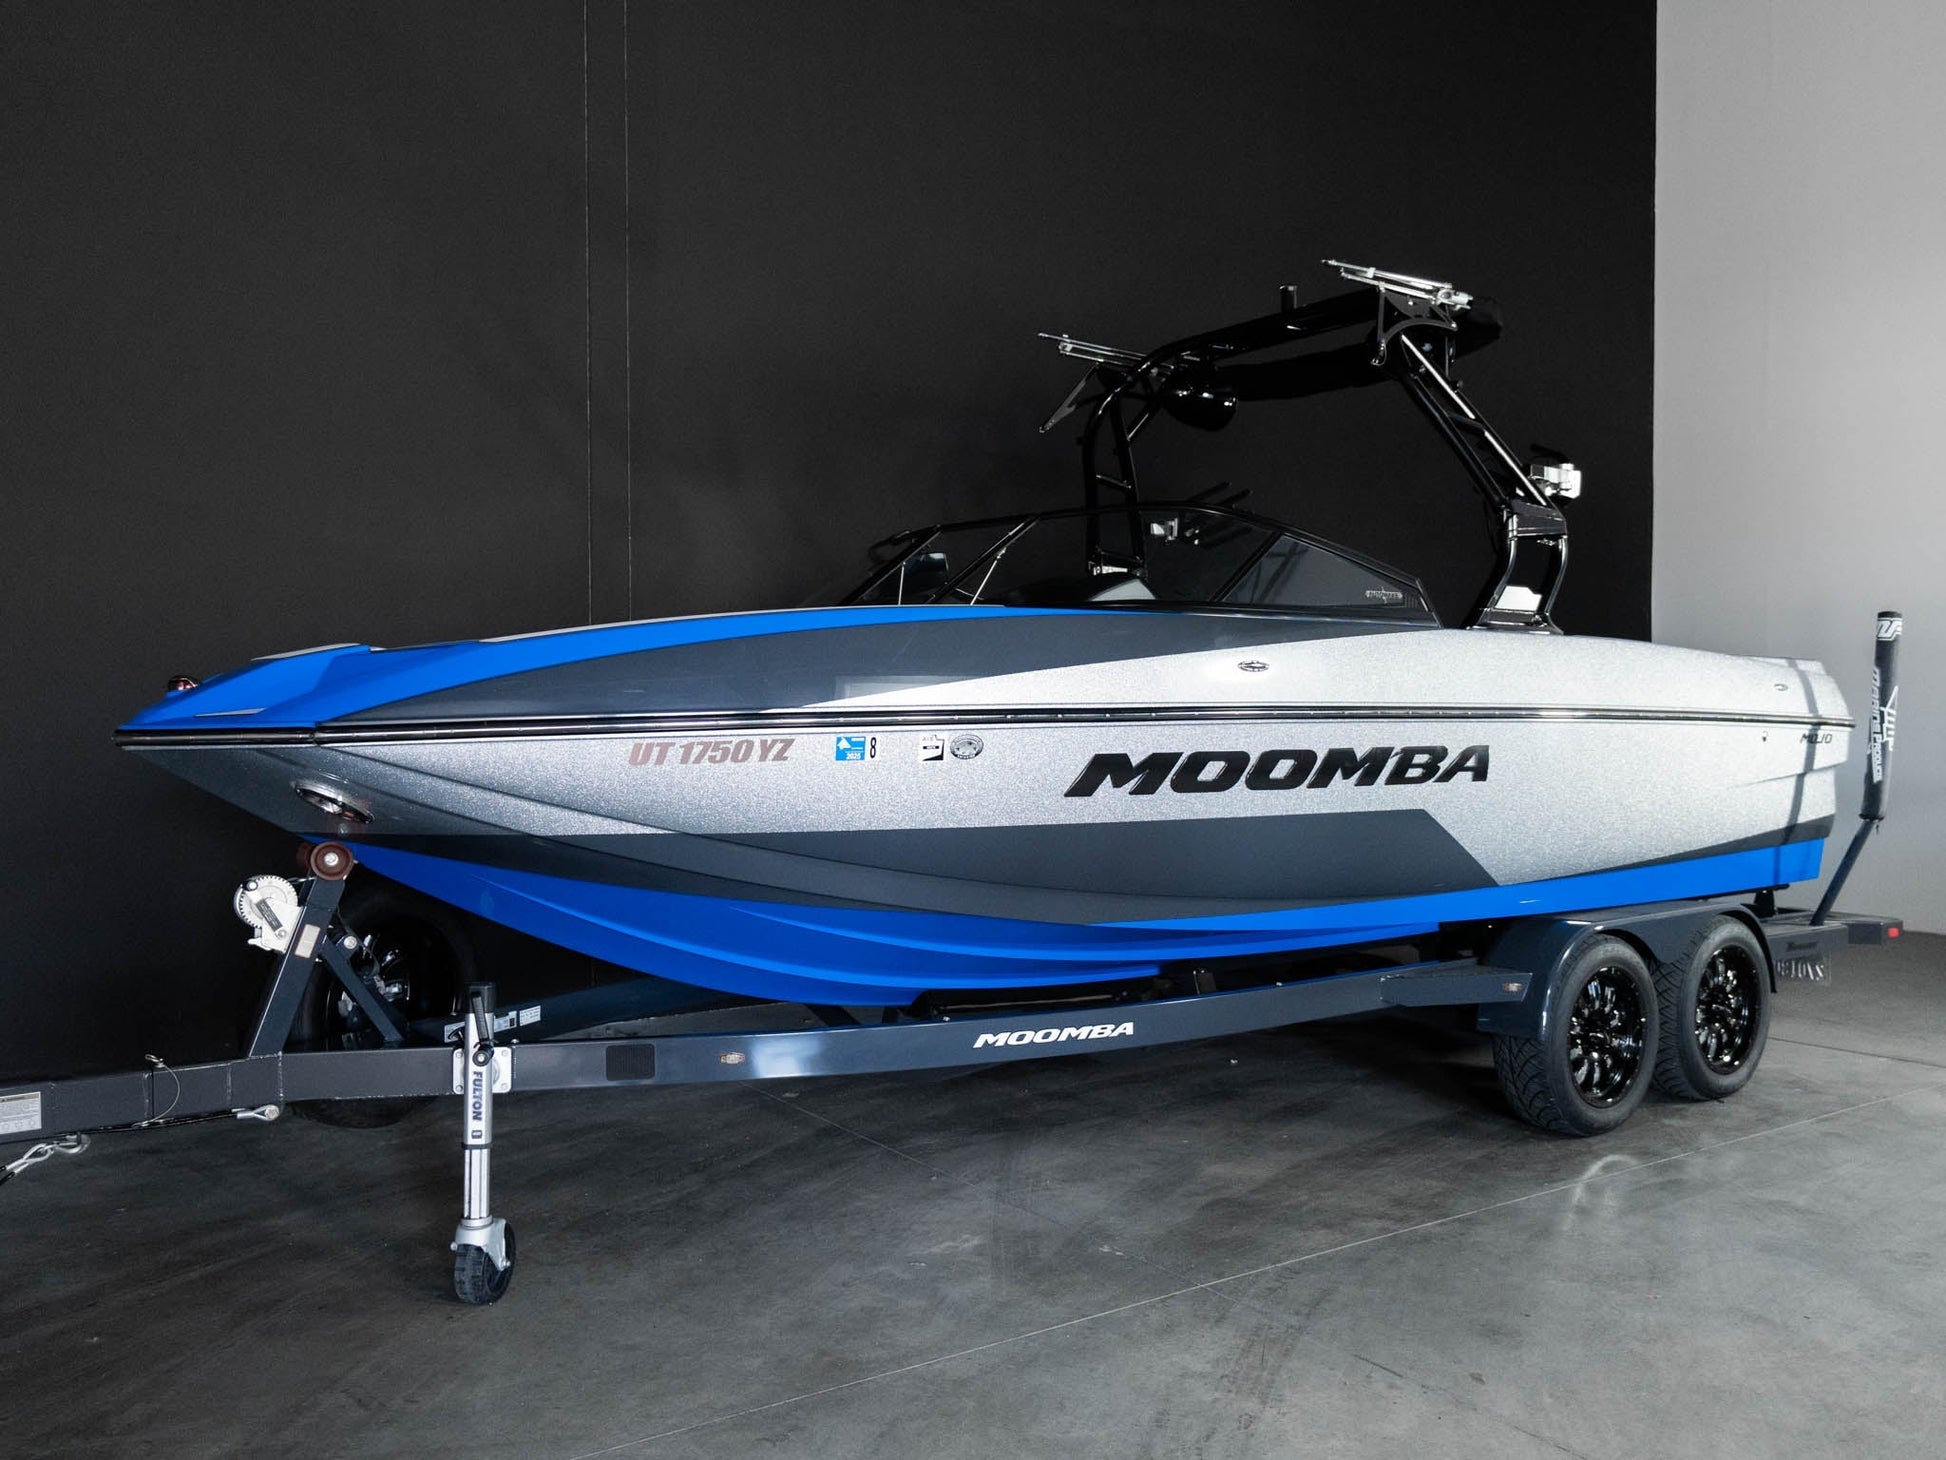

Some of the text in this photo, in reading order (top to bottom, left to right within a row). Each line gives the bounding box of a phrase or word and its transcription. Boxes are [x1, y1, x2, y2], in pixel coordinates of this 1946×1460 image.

[628, 738, 796, 765] UT 1750 YZ
[869, 736, 877, 759] 8
[1063, 745, 1490, 798] MOOMBA
[973, 1022, 1134, 1048] MOOMBA
[472, 1070, 483, 1122] FULTON
